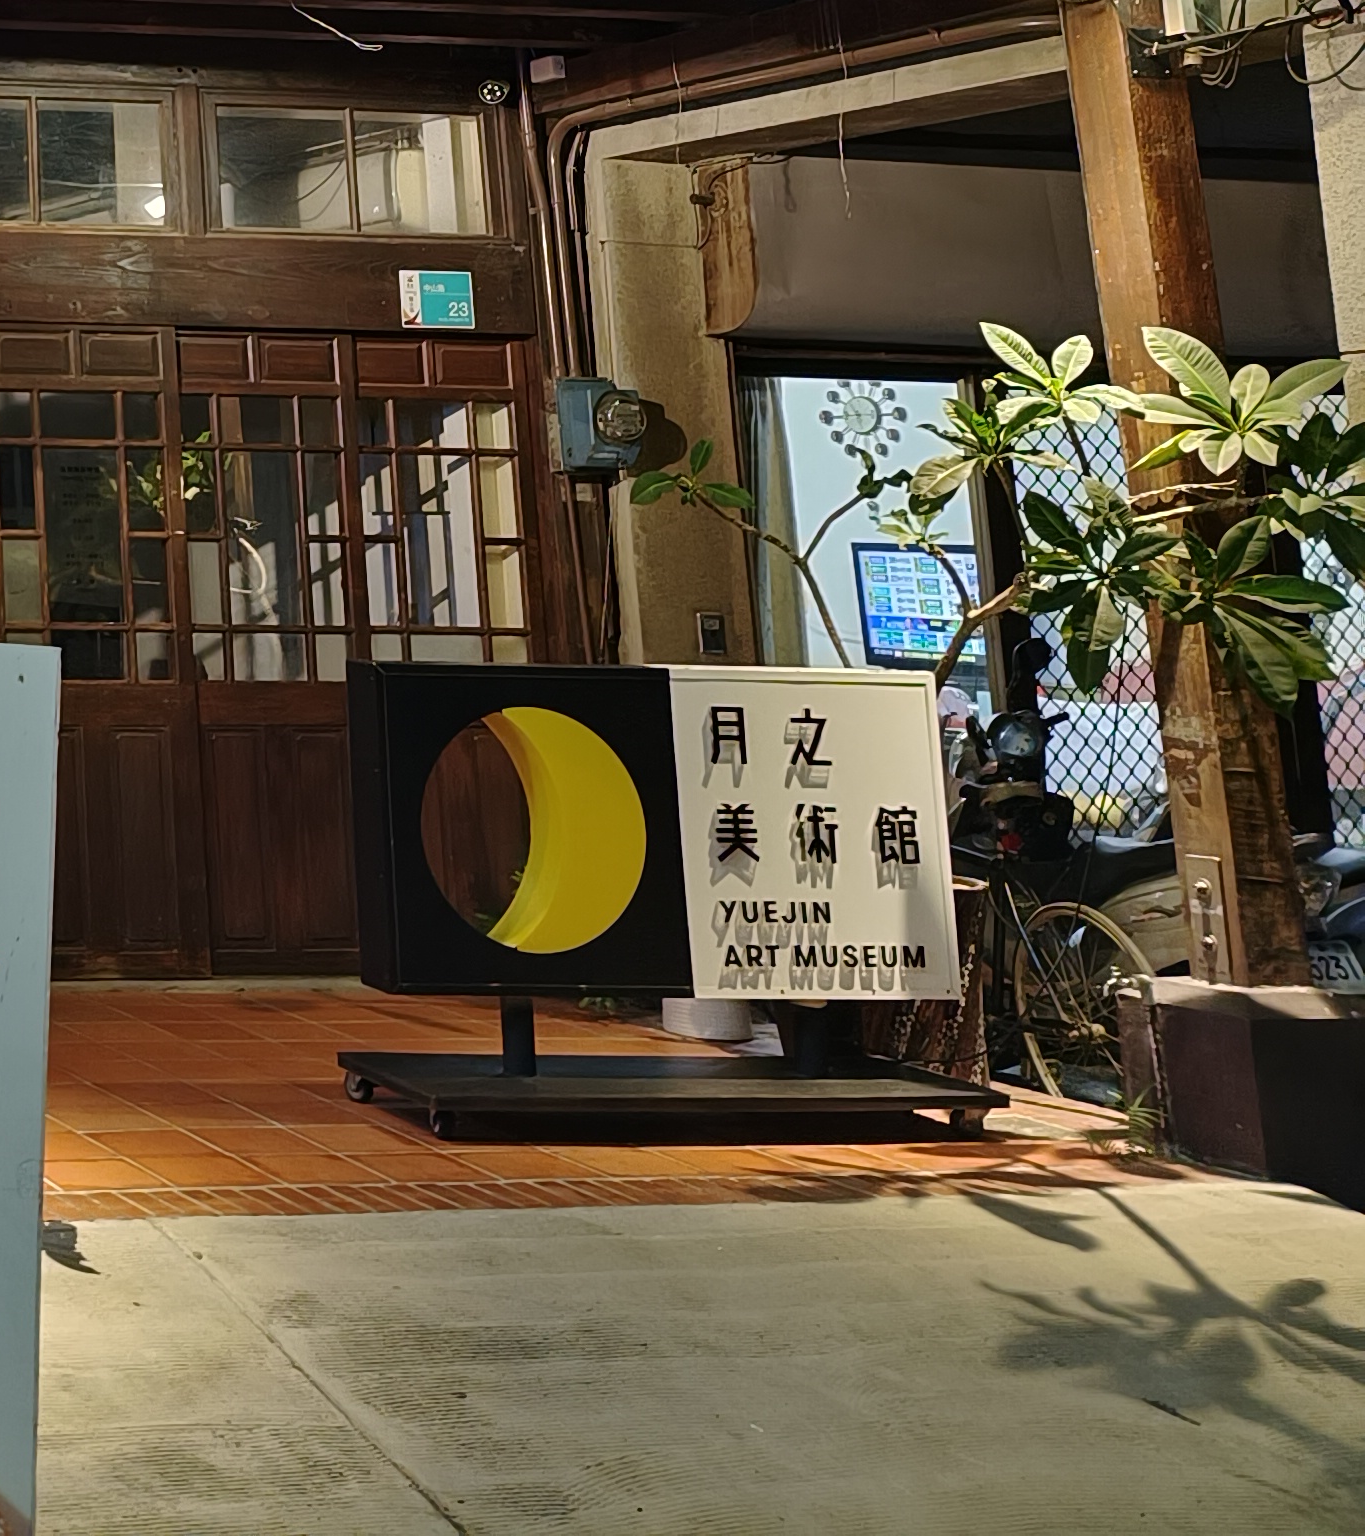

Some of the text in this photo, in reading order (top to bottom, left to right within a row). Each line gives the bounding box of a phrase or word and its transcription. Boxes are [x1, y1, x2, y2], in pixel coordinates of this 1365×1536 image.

[449, 301, 469, 317] 23
[710, 706, 833, 765] 月之
[715, 803, 921, 864] 美術館
[719, 901, 831, 924] YUEJIN
[724, 945, 926, 968] ART MUSEUM
